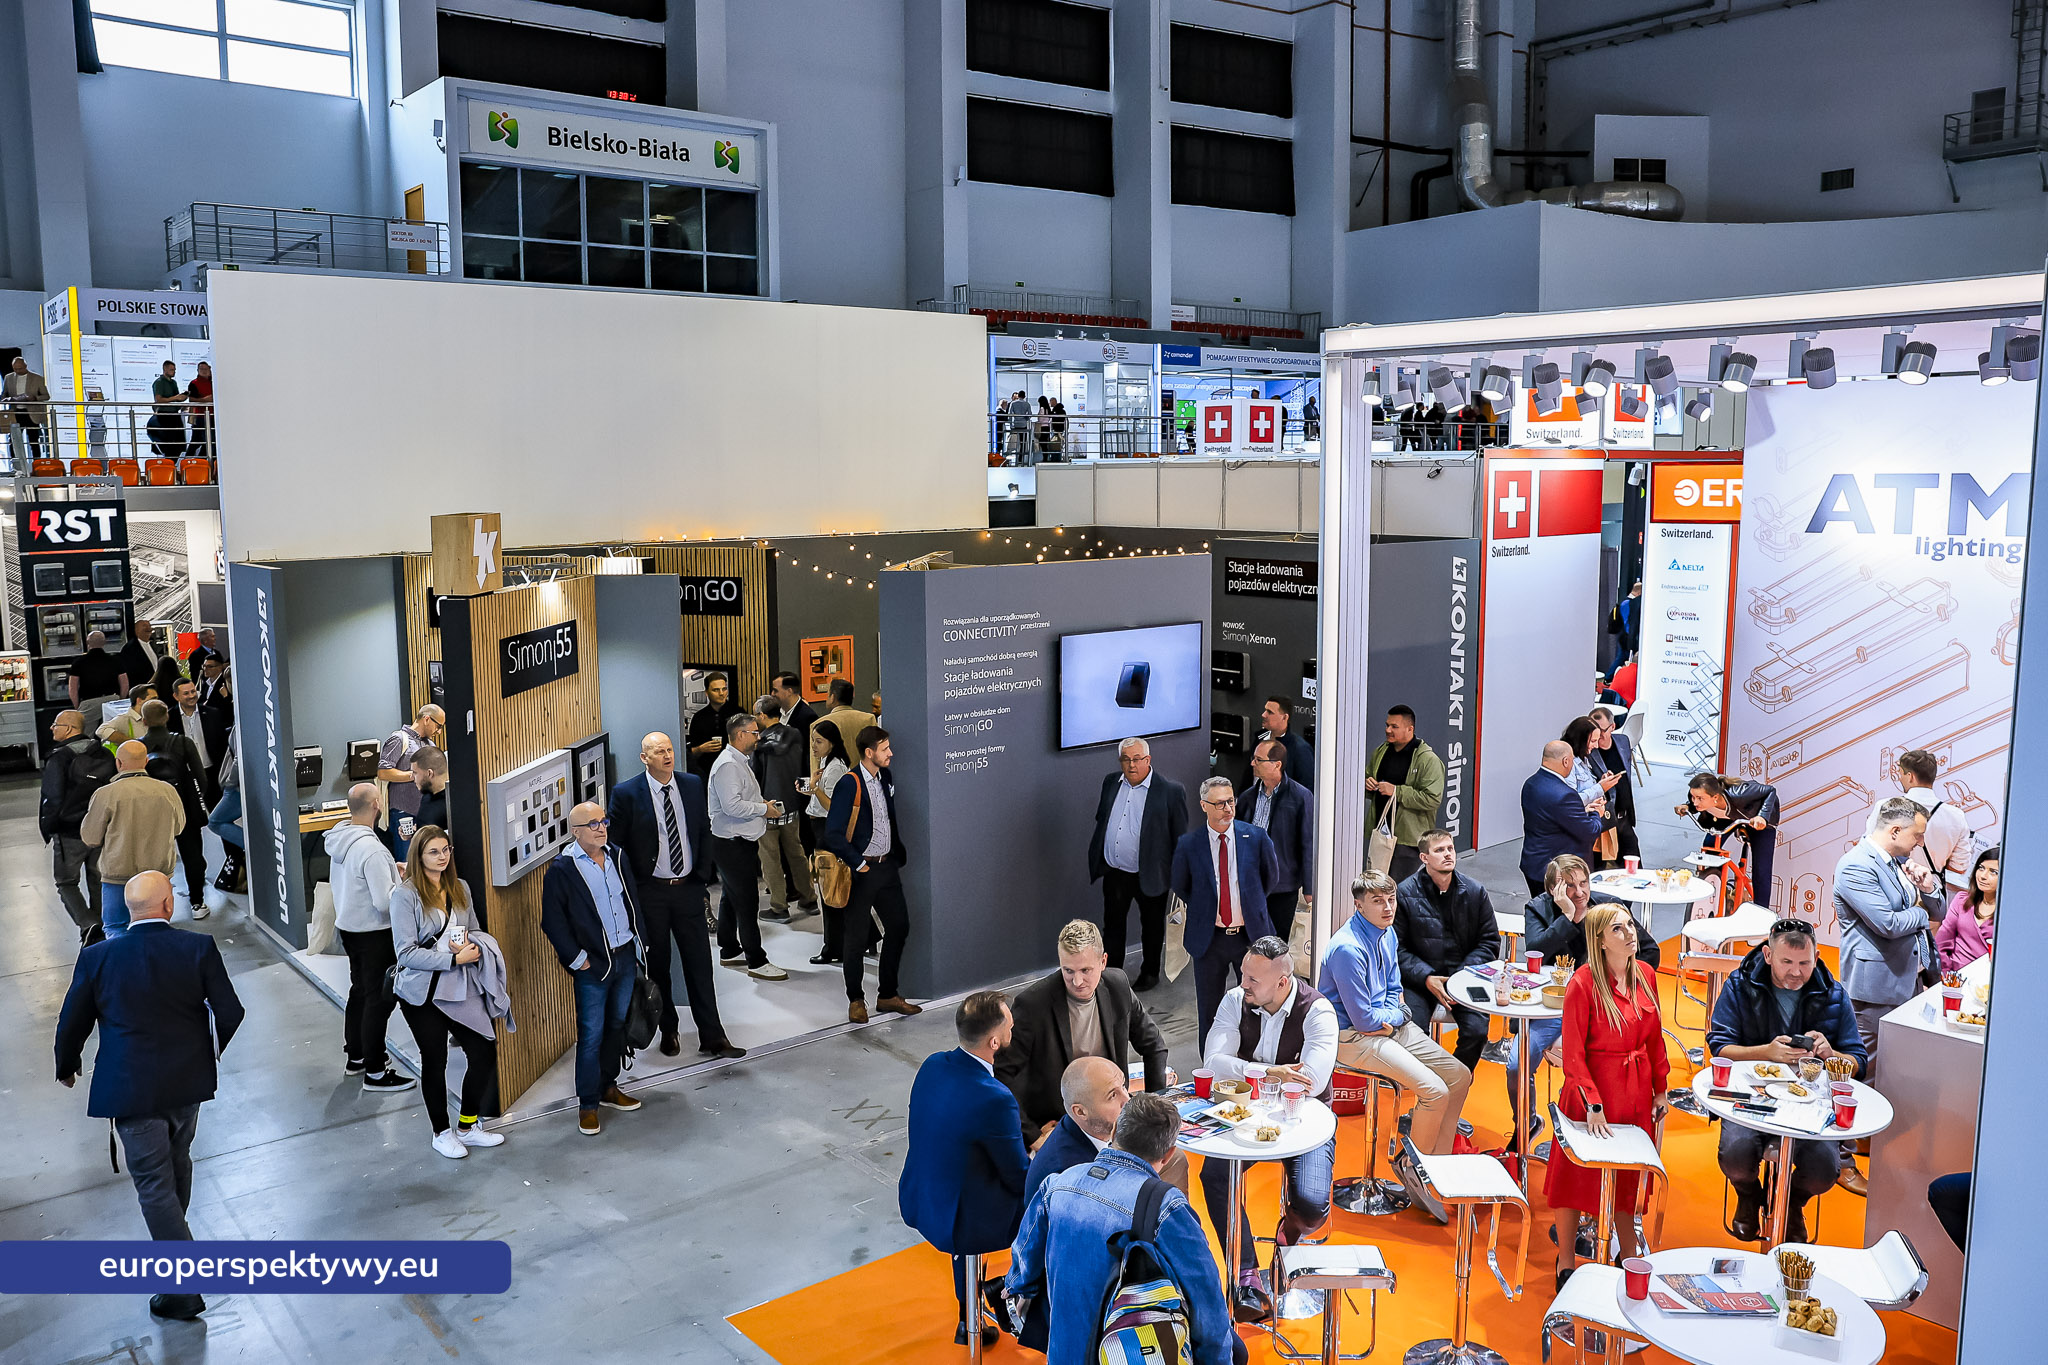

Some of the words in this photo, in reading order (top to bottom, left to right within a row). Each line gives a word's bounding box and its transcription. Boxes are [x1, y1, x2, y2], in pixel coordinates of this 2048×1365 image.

[547, 126, 691, 162] Bielsko-Biała
[97, 300, 157, 314] POLSKIE
[161, 303, 208, 316] STOWA
[1206, 353, 1237, 362] POMAGAMY
[1238, 356, 1270, 364] EFEKTYWNIE
[1271, 356, 1311, 366] GOSPODAROWAĆ
[1526, 428, 1583, 439] Switzerland.
[1613, 428, 1645, 439] Switzerland.
[1805, 473, 2031, 537] ATM
[40, 508, 117, 543] RST
[1661, 528, 1714, 539] Switzerland.
[1491, 544, 1530, 558] Switzerland.
[1915, 536, 2023, 564] lighting
[1228, 561, 1254, 576] Stacje
[1256, 562, 1304, 577] ładowania
[1228, 578, 1270, 592] pojazdów
[943, 617, 979, 626] Rozwiązania
[980, 615, 989, 623] dla
[990, 611, 1040, 624] uporządkowanych
[943, 624, 1018, 642] CONNECTIVITY
[1020, 621, 1050, 632] przestrzeni
[943, 656, 967, 666] Naładuj
[968, 653, 998, 664] samochód
[998, 652, 1016, 661] dobrą
[1016, 649, 1038, 660] energią
[1448, 583, 1467, 731] KONTAKT
[944, 672, 970, 684] Stacje
[970, 666, 1014, 680] ładowania
[944, 684, 986, 700] pojazdów
[986, 676, 1042, 692] elektrycznych
[258, 620, 281, 800] KONTAKT
[944, 713, 962, 722] Łatwy
[997, 706, 1010, 714] dom
[1666, 734, 1686, 742] ZREW
[946, 750, 966, 760] Piękno
[966, 746, 987, 758] prostej
[988, 744, 1006, 753] formy
